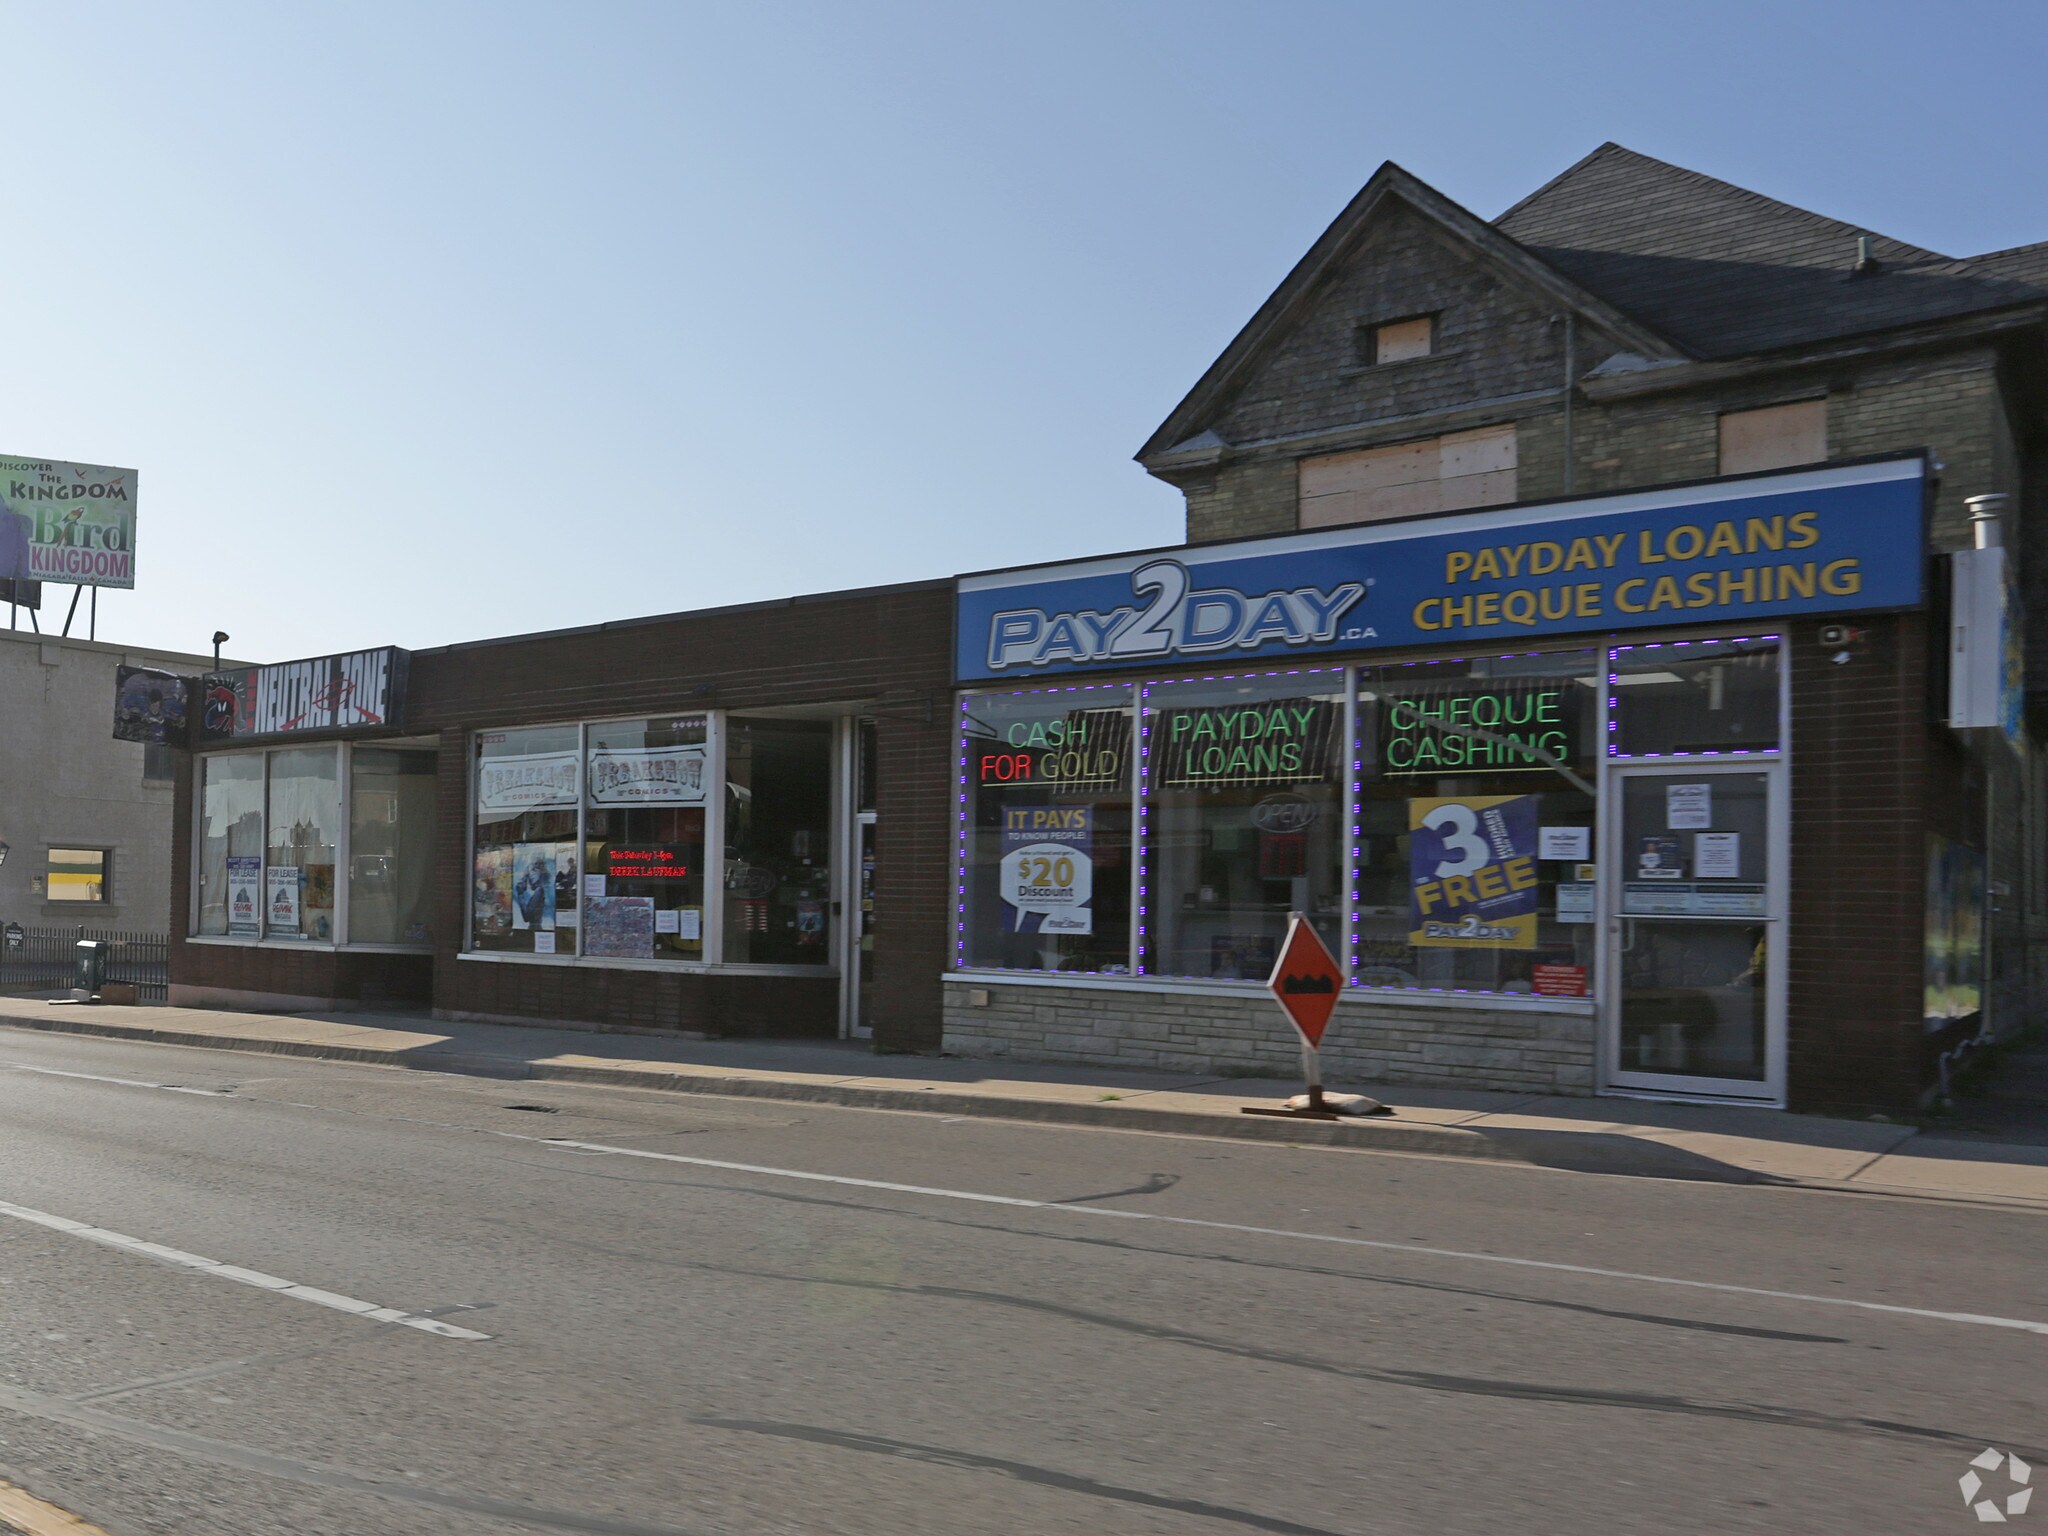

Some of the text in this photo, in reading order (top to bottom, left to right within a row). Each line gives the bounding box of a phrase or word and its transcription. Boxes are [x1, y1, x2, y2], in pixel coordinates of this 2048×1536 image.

[10, 480, 128, 501] KINGDOM
[39, 474, 62, 484] THE
[30, 505, 131, 552] Bird
[31, 546, 129, 578] KINGDOM
[1445, 511, 1820, 584] PAYDAY LOANS
[33, 572, 65, 580] NIAGARA
[98, 577, 127, 585] CANADA
[1412, 558, 1862, 631] CHEQUE CASHING
[254, 659, 331, 733] NEUTRAL
[337, 651, 388, 727] ZONE
[1007, 719, 1087, 749] CASH
[1172, 707, 1317, 743] PAYDAY
[1387, 692, 1568, 767] CHEQUE CASHING
[980, 750, 1118, 781] FOR GOLD
[1186, 743, 1301, 776] LOANS
[511, 792, 546, 800] COMICS
[627, 788, 669, 796] COMICS
[1007, 809, 1087, 829] IT PAYS
[1258, 804, 1312, 823] OPEN
[1008, 832, 1020, 840] TO
[1421, 803, 1491, 878] 3
[240, 869, 257, 878] LEASE
[268, 869, 297, 878] FOR LEASE
[1018, 857, 1075, 888] $20
[1414, 856, 1539, 915] FREE
[1018, 885, 1074, 897] Discount
